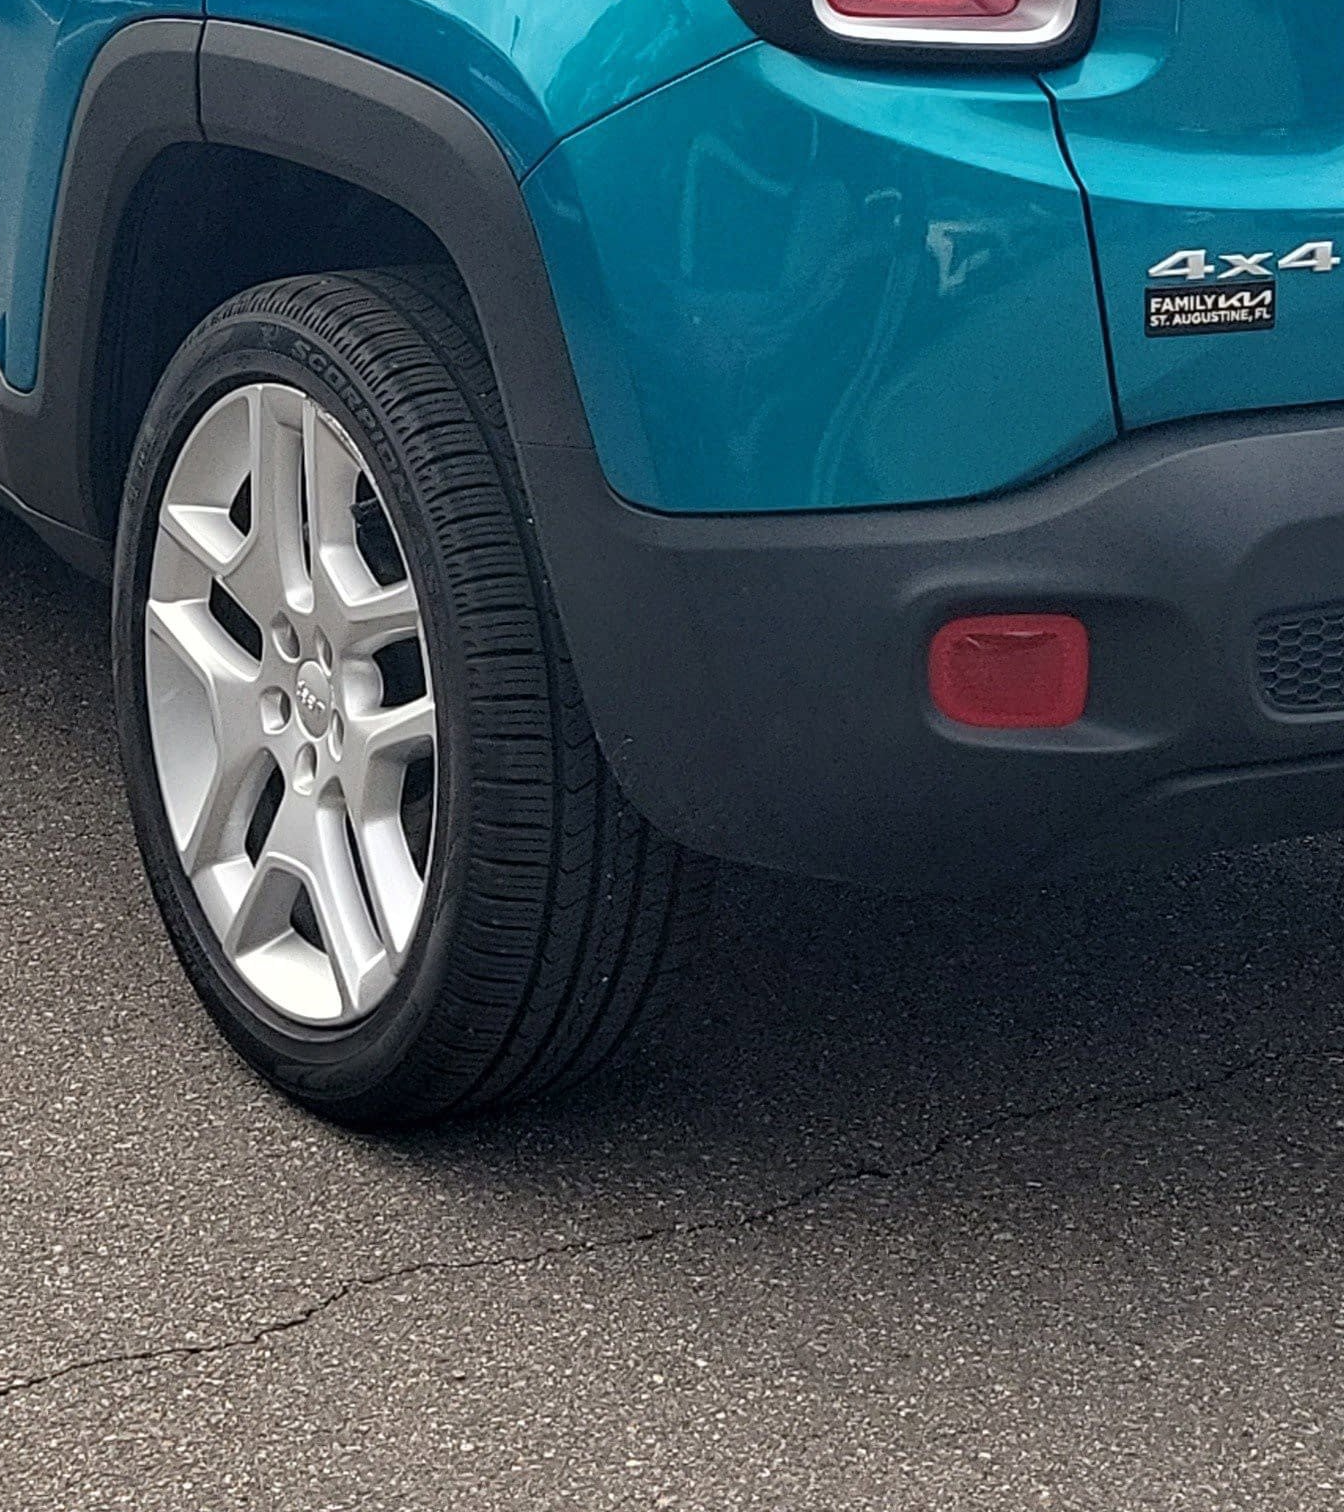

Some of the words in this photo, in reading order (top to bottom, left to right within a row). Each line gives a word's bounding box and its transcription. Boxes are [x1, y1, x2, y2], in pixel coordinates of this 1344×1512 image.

[1148, 240, 1342, 280] 4x4
[1149, 294, 1217, 313] FAMILY
[1217, 289, 1273, 309] KIA
[1149, 315, 1170, 328] ST.
[1171, 308, 1253, 326] AUGUSTINE,
[1254, 306, 1272, 320] FL
